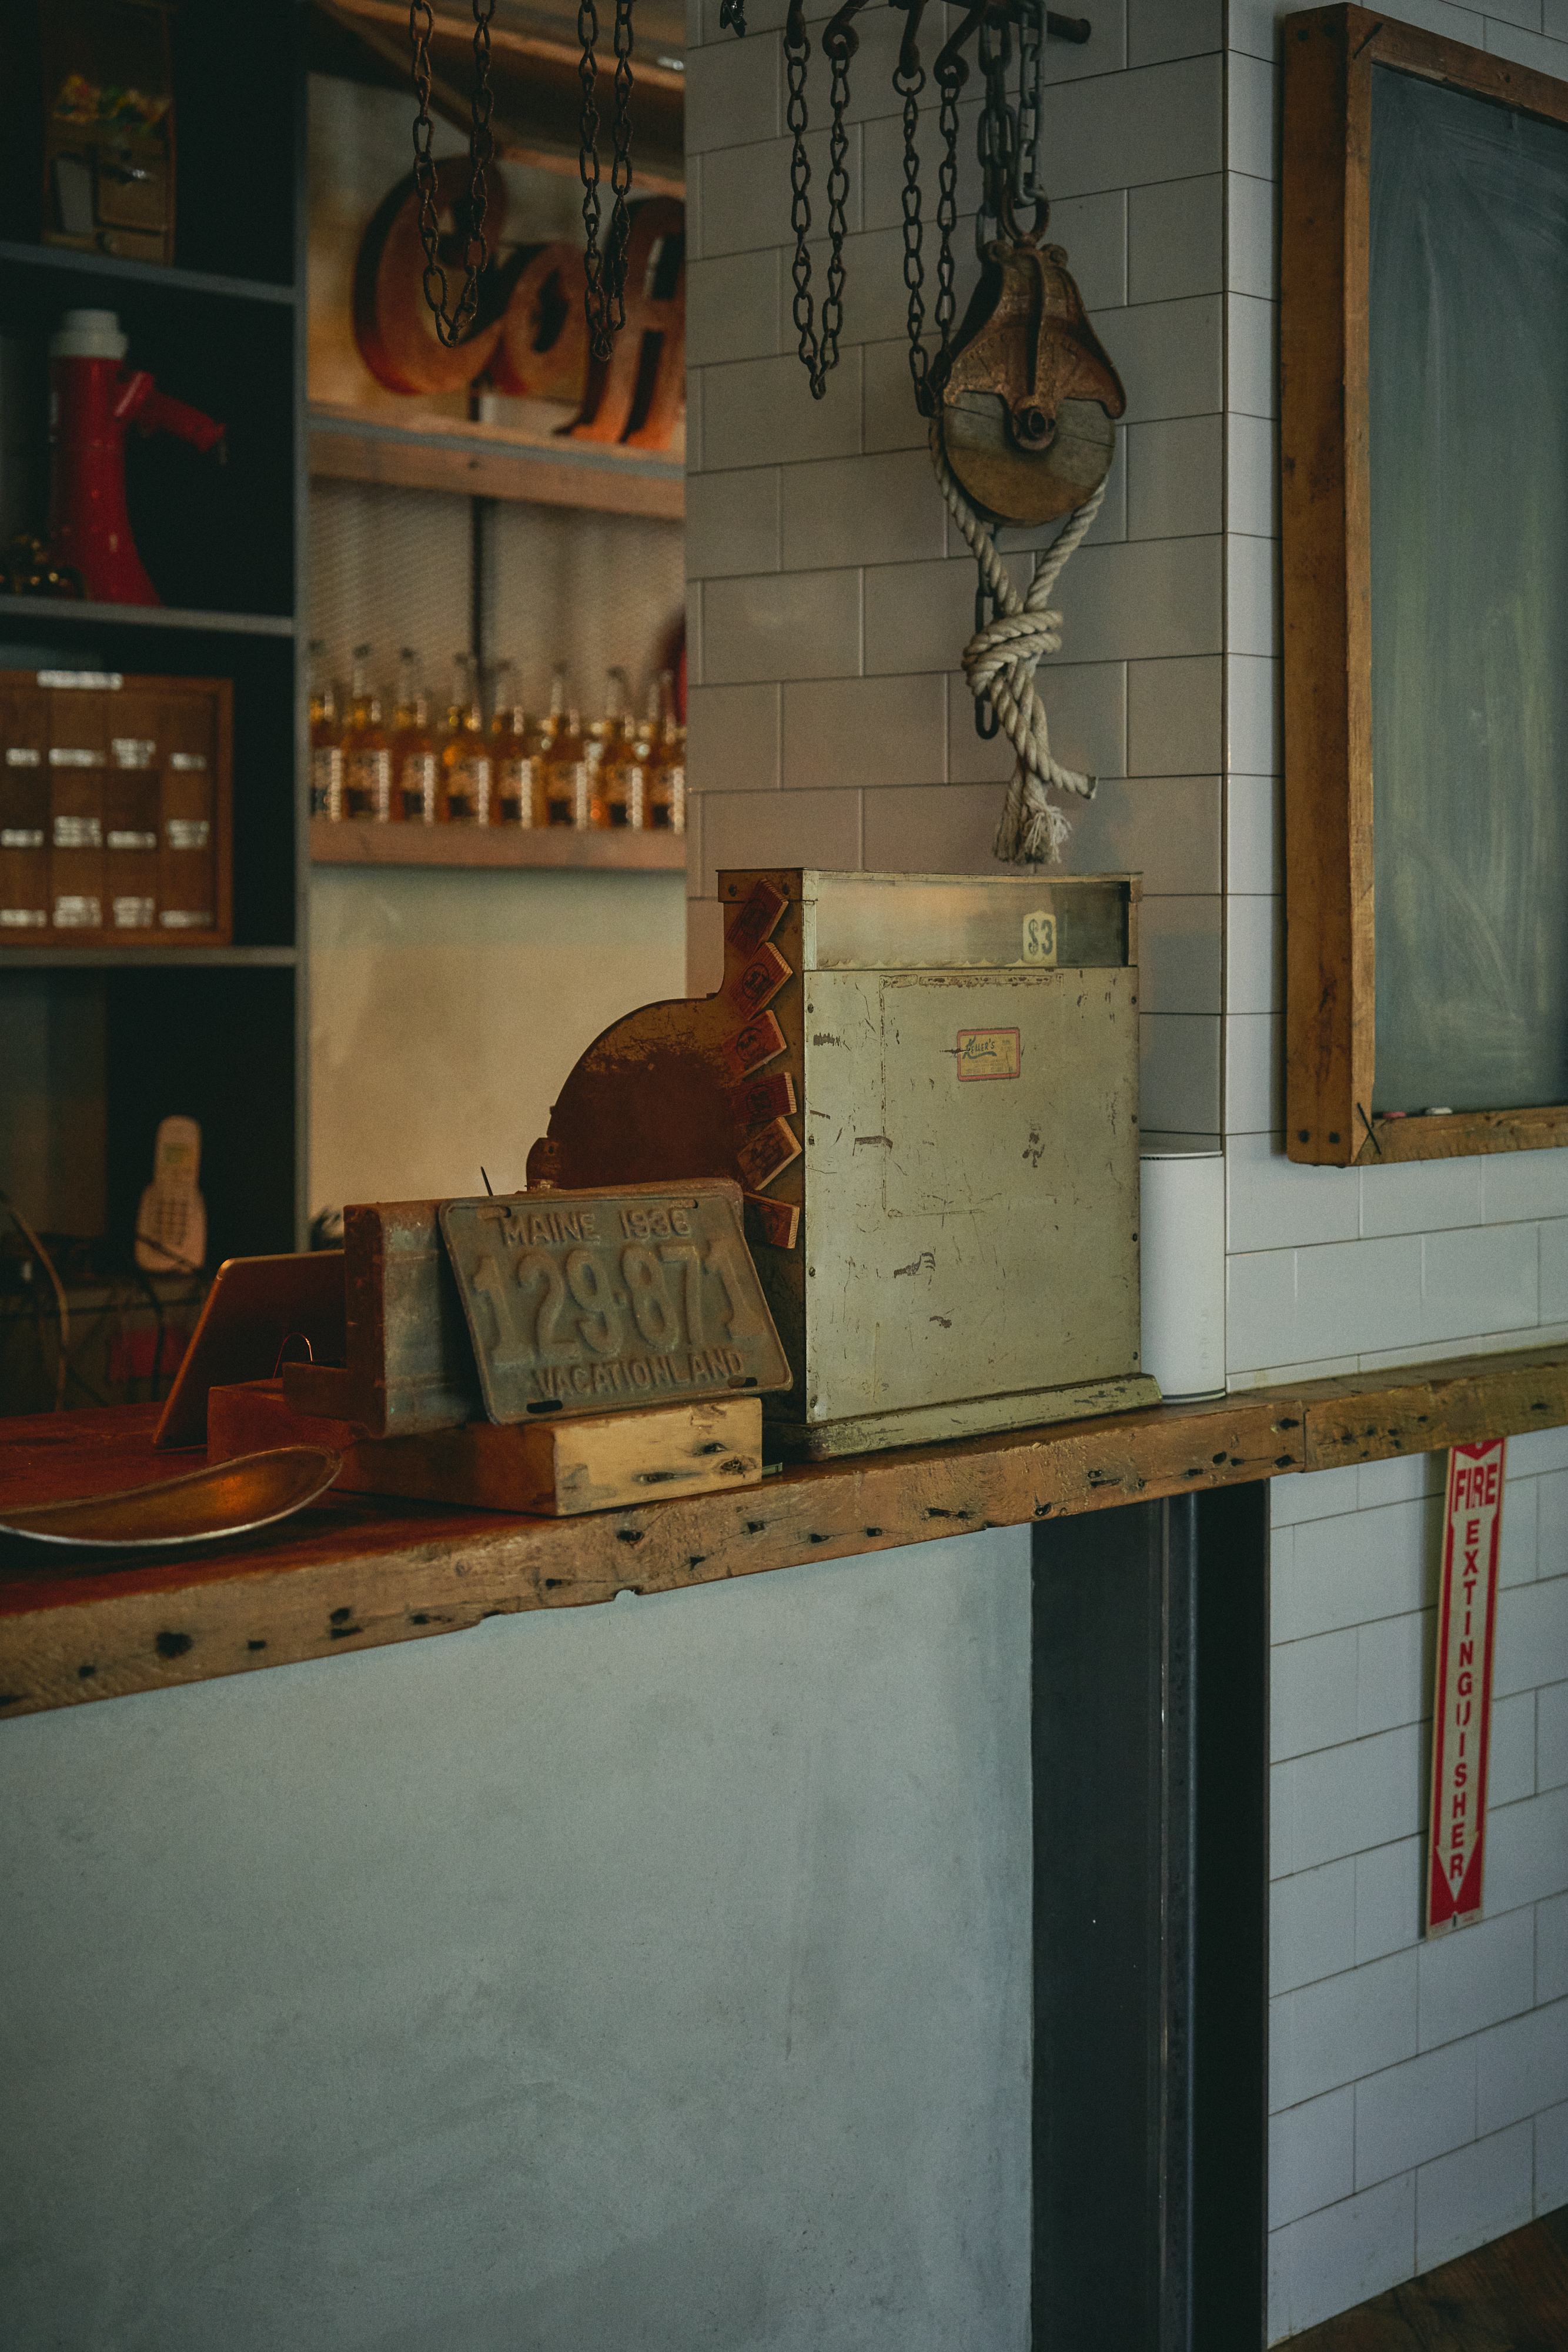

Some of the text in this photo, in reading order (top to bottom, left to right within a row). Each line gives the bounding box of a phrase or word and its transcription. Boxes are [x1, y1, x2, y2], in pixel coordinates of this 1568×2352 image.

[499, 1207, 693, 1248] MAINE 1936
[531, 1347, 744, 1398] VACATIONLAND
[1453, 1462, 1498, 1513] FIRE
[1449, 1518, 1480, 1880] EXTINGUISHER
